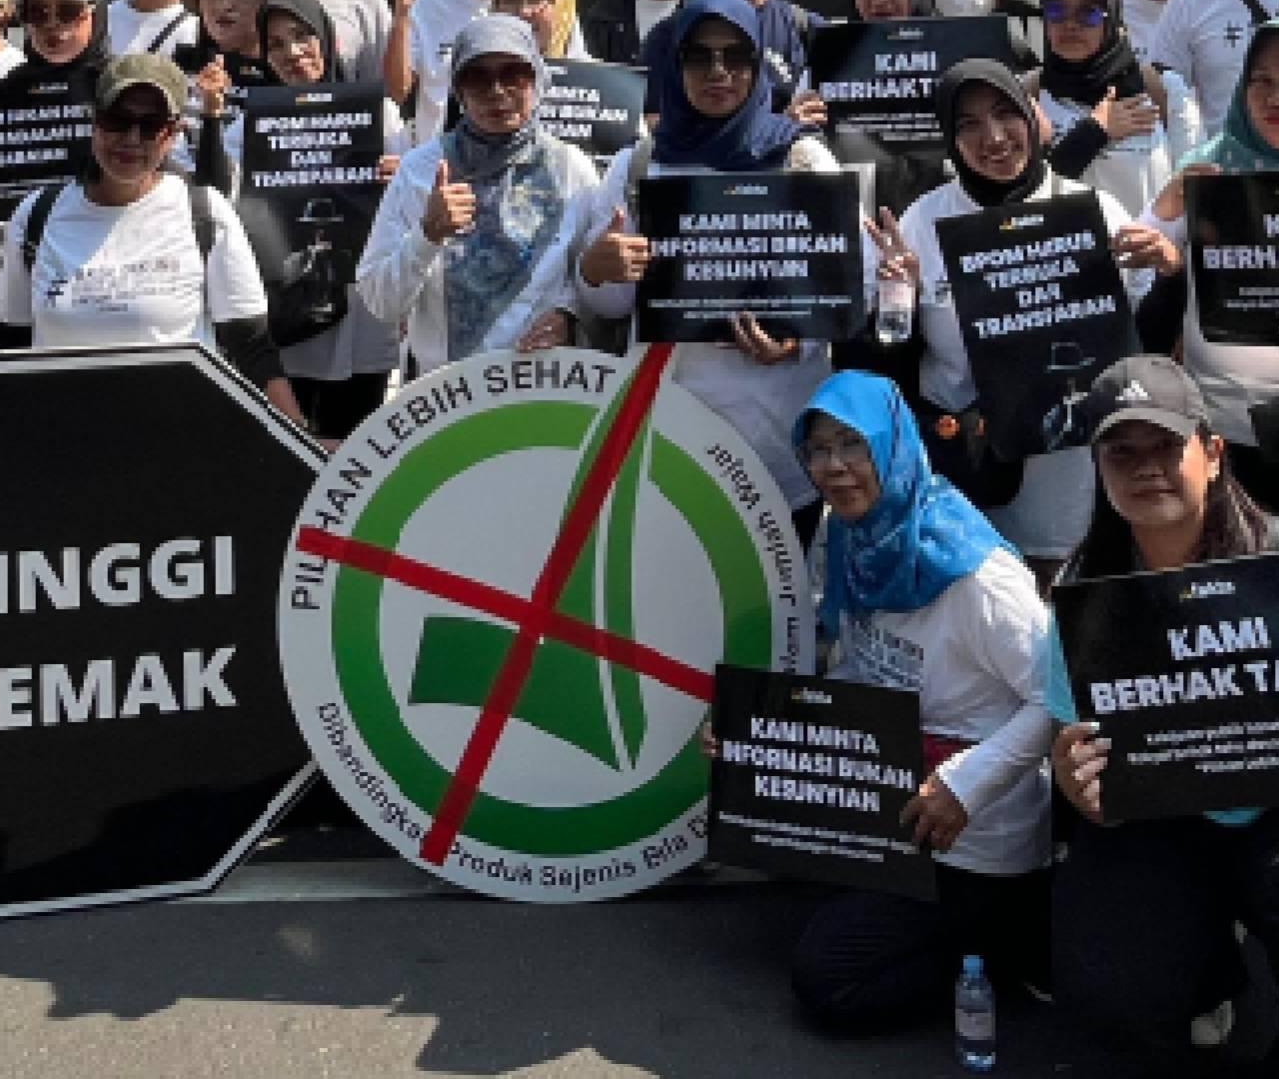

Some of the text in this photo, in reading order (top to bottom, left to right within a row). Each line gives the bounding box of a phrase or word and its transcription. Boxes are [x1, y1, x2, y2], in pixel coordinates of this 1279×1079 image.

[874, 51, 938, 73] KAMI
[821, 78, 919, 102] BERHAK
[290, 150, 332, 167] DAN
[678, 212, 811, 233] KAMI MINTA
[771, 235, 848, 254] BUKAN
[959, 230, 1096, 273] BPOM HARUS
[974, 295, 1116, 339] TRANSPARAN
[1017, 283, 1061, 308] DAN
[291, 359, 618, 612] PILHAN LEBIH SEHAT
[703, 440, 762, 511] Wajar
[756, 510, 797, 608] Jumlah
[1167, 617, 1270, 661] KAMI
[1090, 666, 1243, 715] BERHAK
[750, 716, 880, 756] KAMI MINTA
[722, 740, 914, 792] INFORMASI BUKAN
[317, 701, 426, 844] Dibandingka
[538, 858, 637, 895] Sejenis
